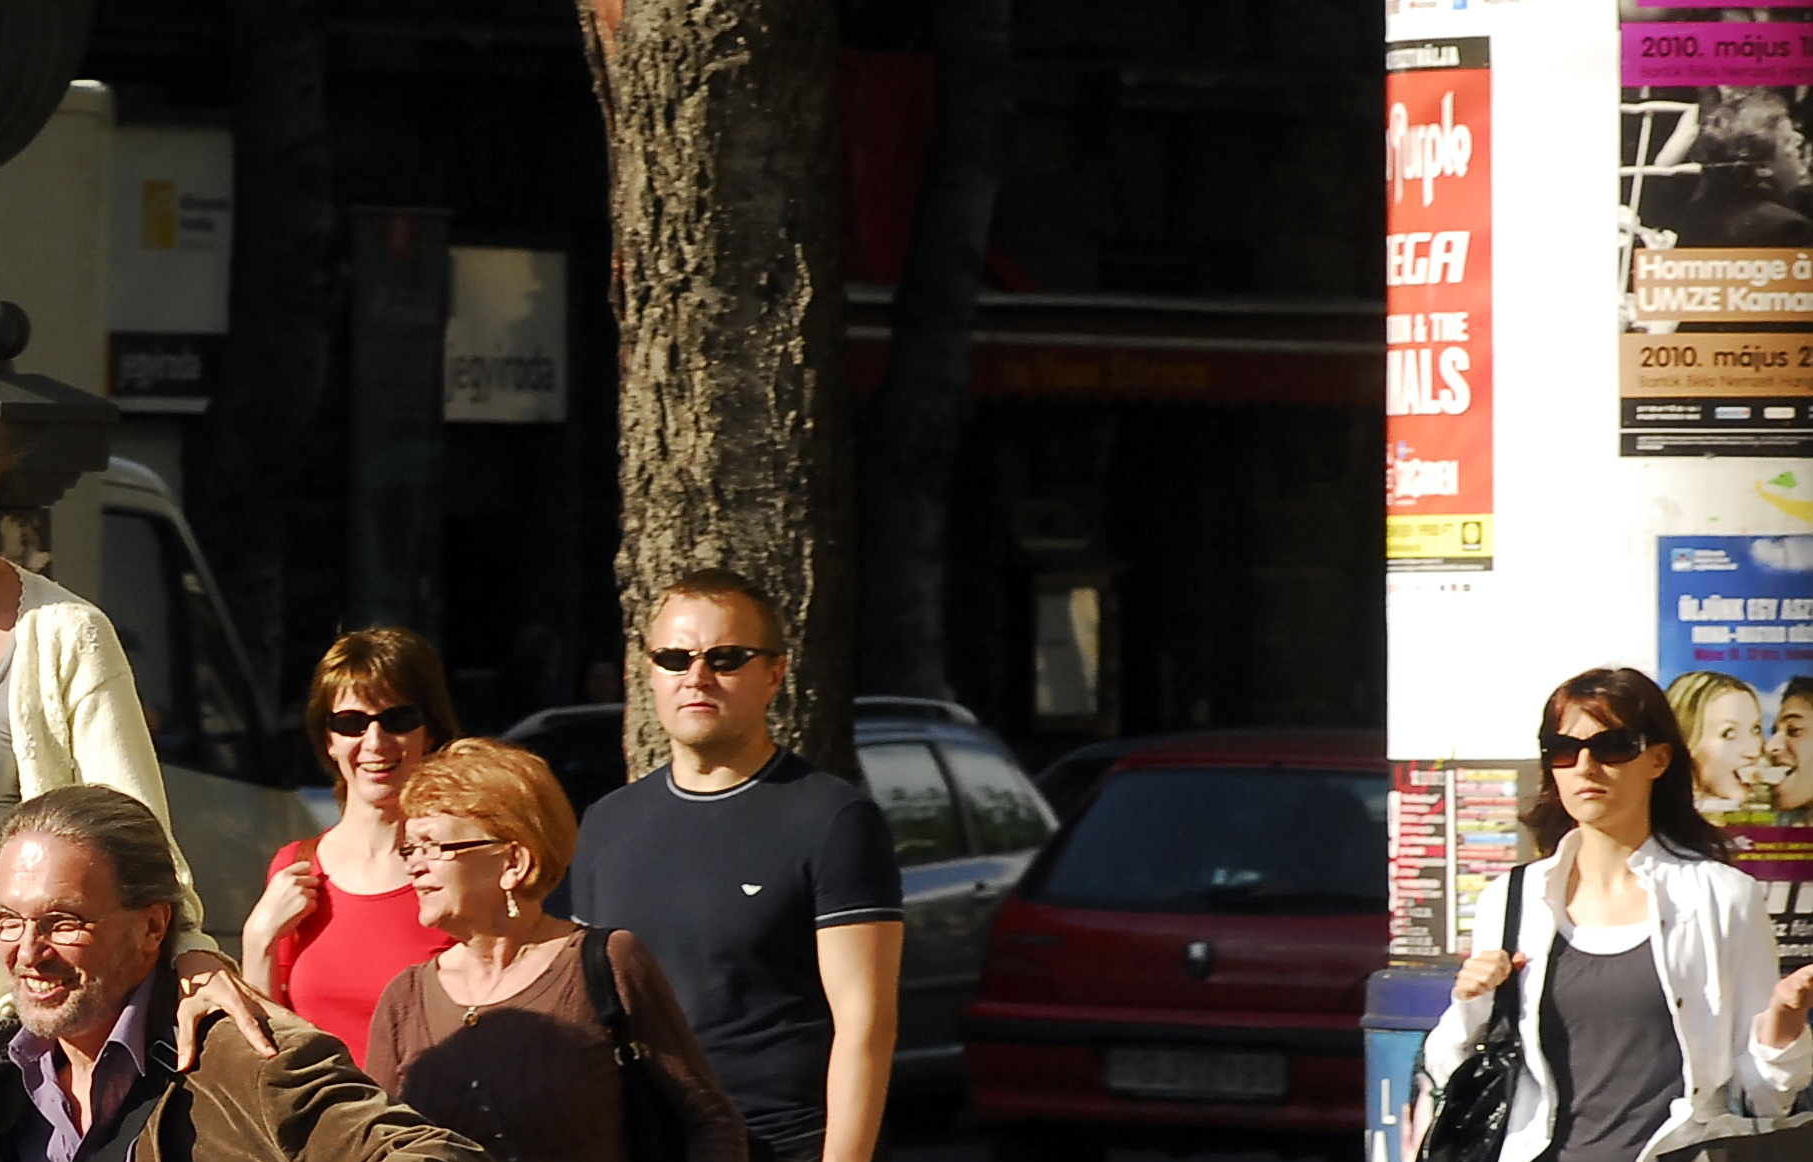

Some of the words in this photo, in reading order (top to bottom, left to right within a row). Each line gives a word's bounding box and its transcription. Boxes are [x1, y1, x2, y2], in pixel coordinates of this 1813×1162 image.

[1641, 36, 1704, 57] 2010.
[1714, 34, 1791, 62] május
[1637, 254, 1787, 286] Hommage
[1638, 287, 1722, 311] UMZE
[1429, 312, 1470, 341] THE
[1640, 345, 1702, 368] 2010.
[1713, 344, 1788, 372] május
